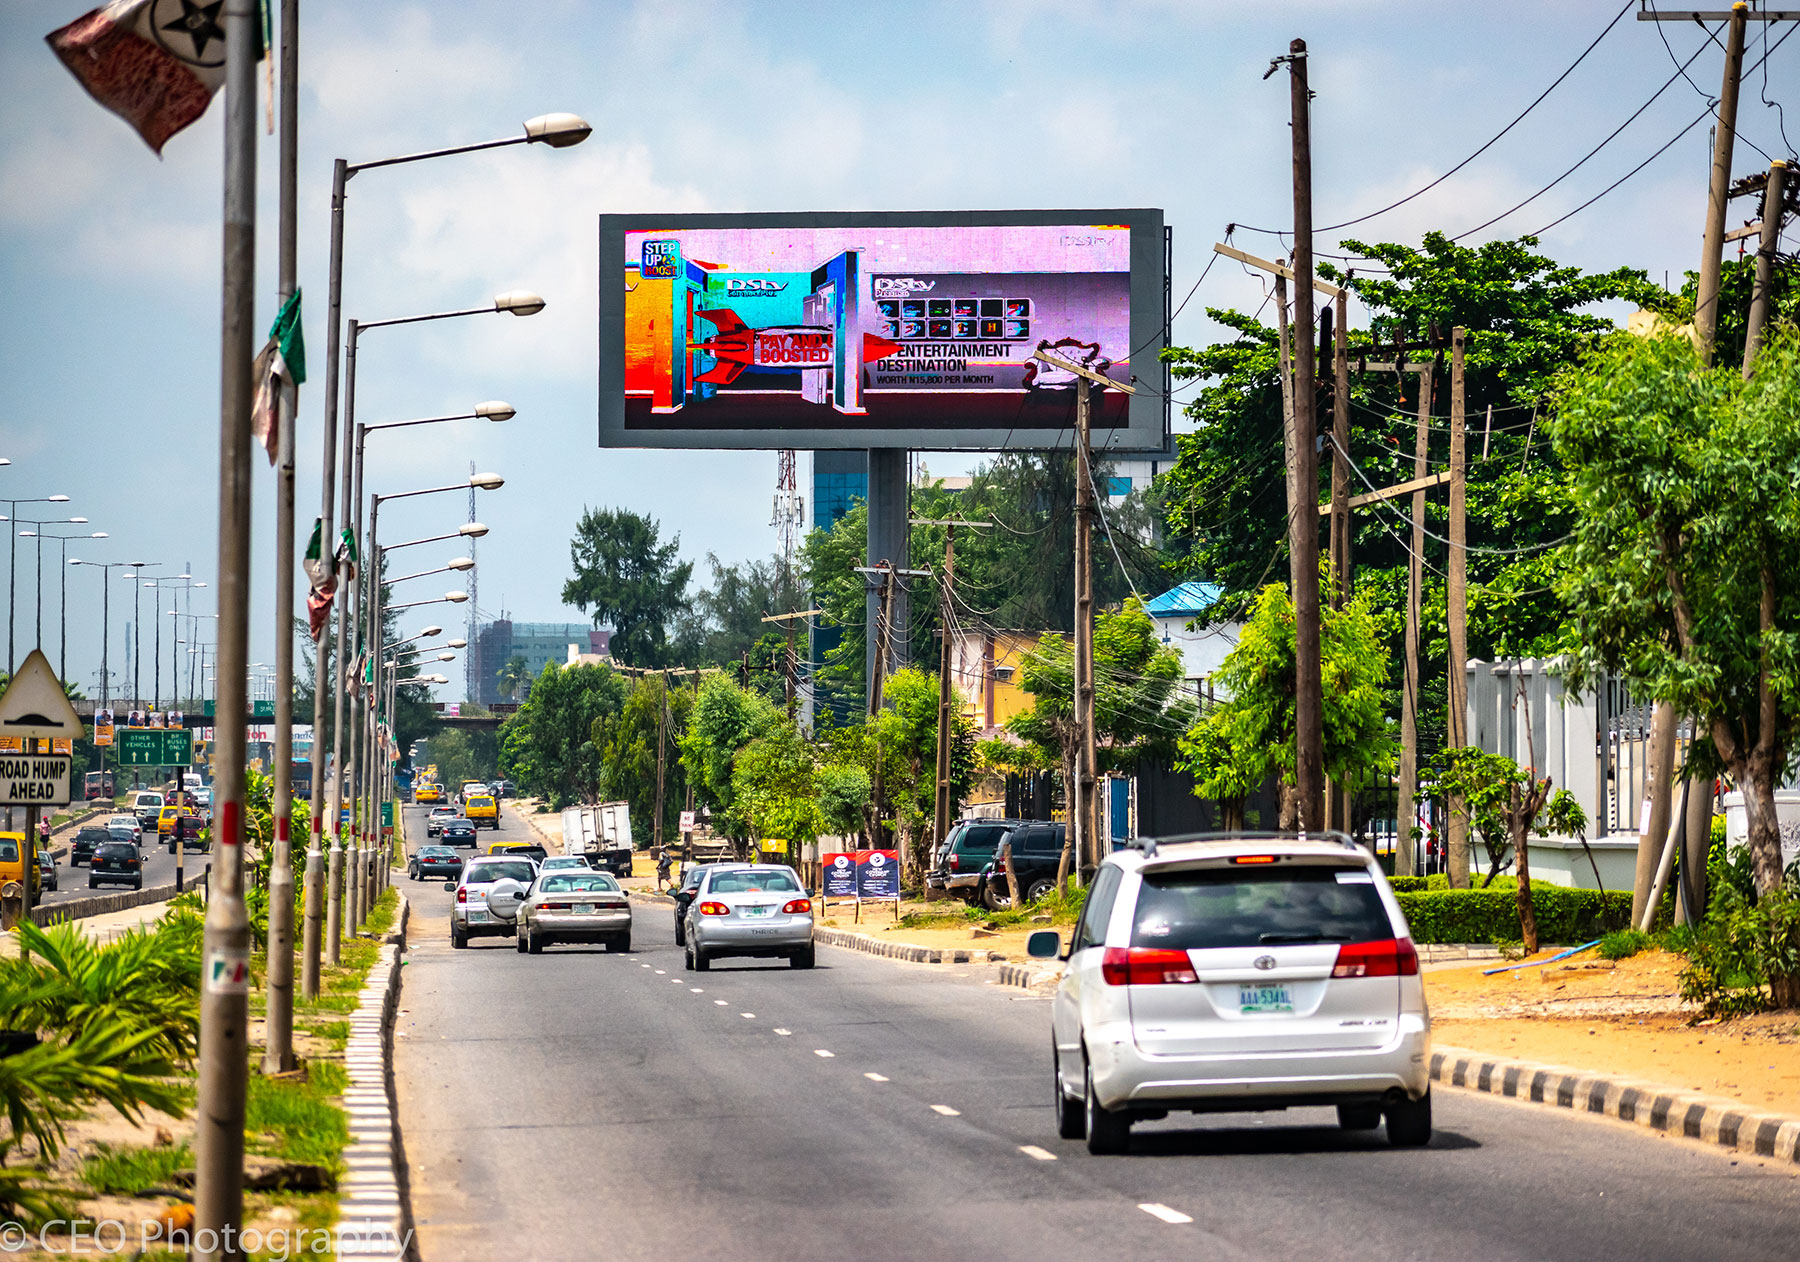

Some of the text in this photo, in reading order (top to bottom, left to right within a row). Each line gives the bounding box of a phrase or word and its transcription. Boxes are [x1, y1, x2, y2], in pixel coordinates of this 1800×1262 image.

[645, 243, 676, 254] STEP
[645, 254, 662, 266] UP
[645, 266, 677, 275] BOOST
[760, 334, 788, 349] PAY
[791, 334, 823, 349] AND
[760, 348, 829, 363] BOOSTED
[897, 344, 1012, 357] ENTERTAINMENT
[877, 359, 967, 372] DESTINATION
[877, 375, 907, 385] WORTH
[945, 375, 961, 384] PER
[963, 375, 994, 384] MONTH
[0, 760, 66, 780] ROAD HUMP
[9, 782, 54, 800] AHEAD
